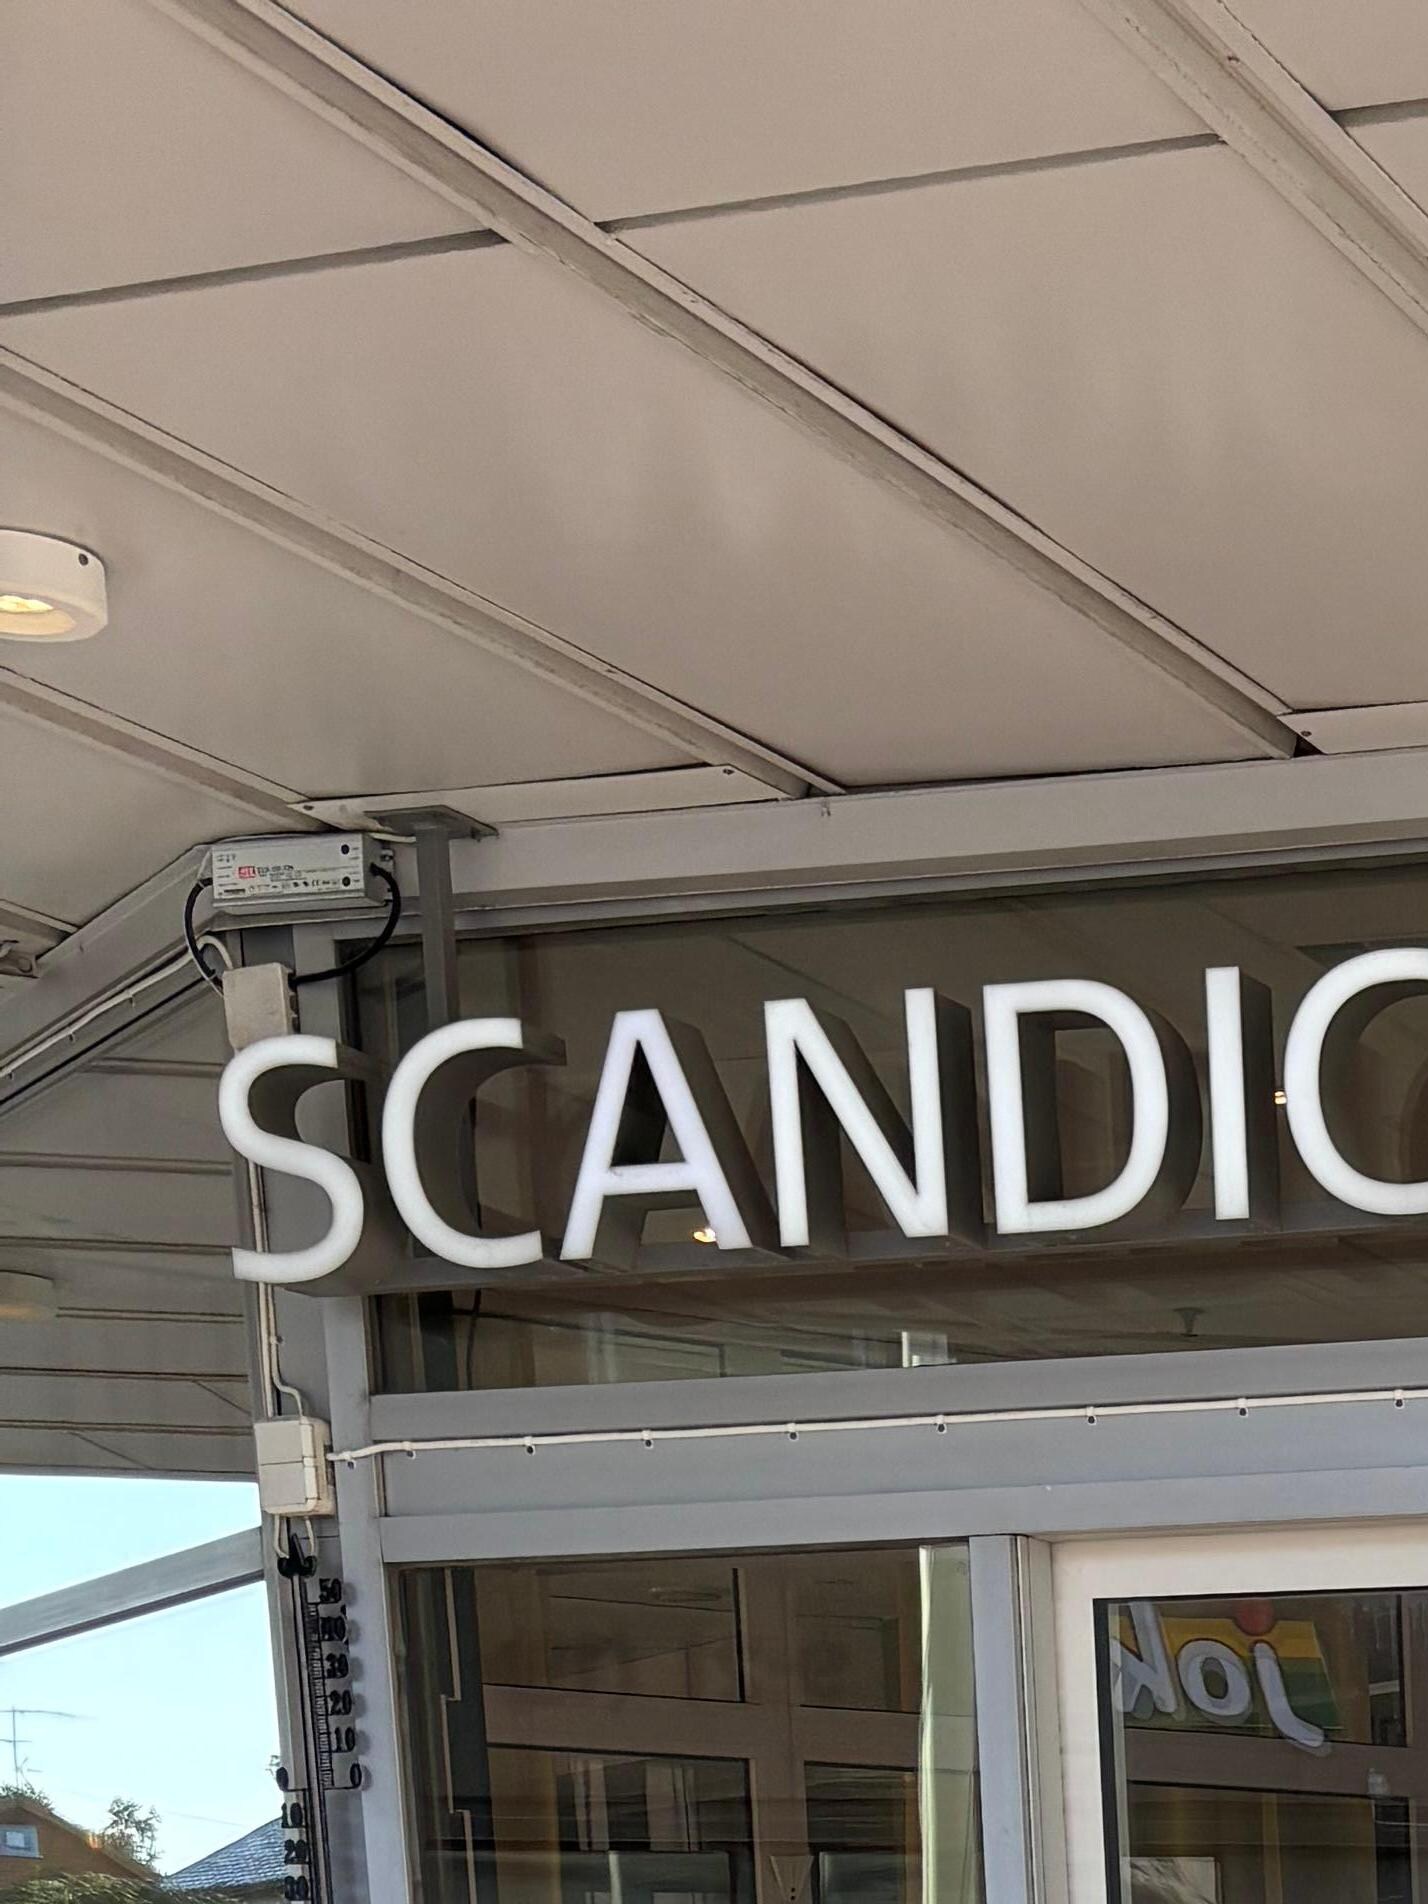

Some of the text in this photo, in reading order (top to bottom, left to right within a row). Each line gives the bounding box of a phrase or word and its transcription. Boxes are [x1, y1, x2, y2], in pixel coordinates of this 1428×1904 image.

[329, 1690, 352, 1715] 20
[335, 1727, 356, 1753] 10
[350, 1763, 362, 1789] 0
[281, 1802, 304, 1828] 10
[284, 1839, 308, 1865] 20
